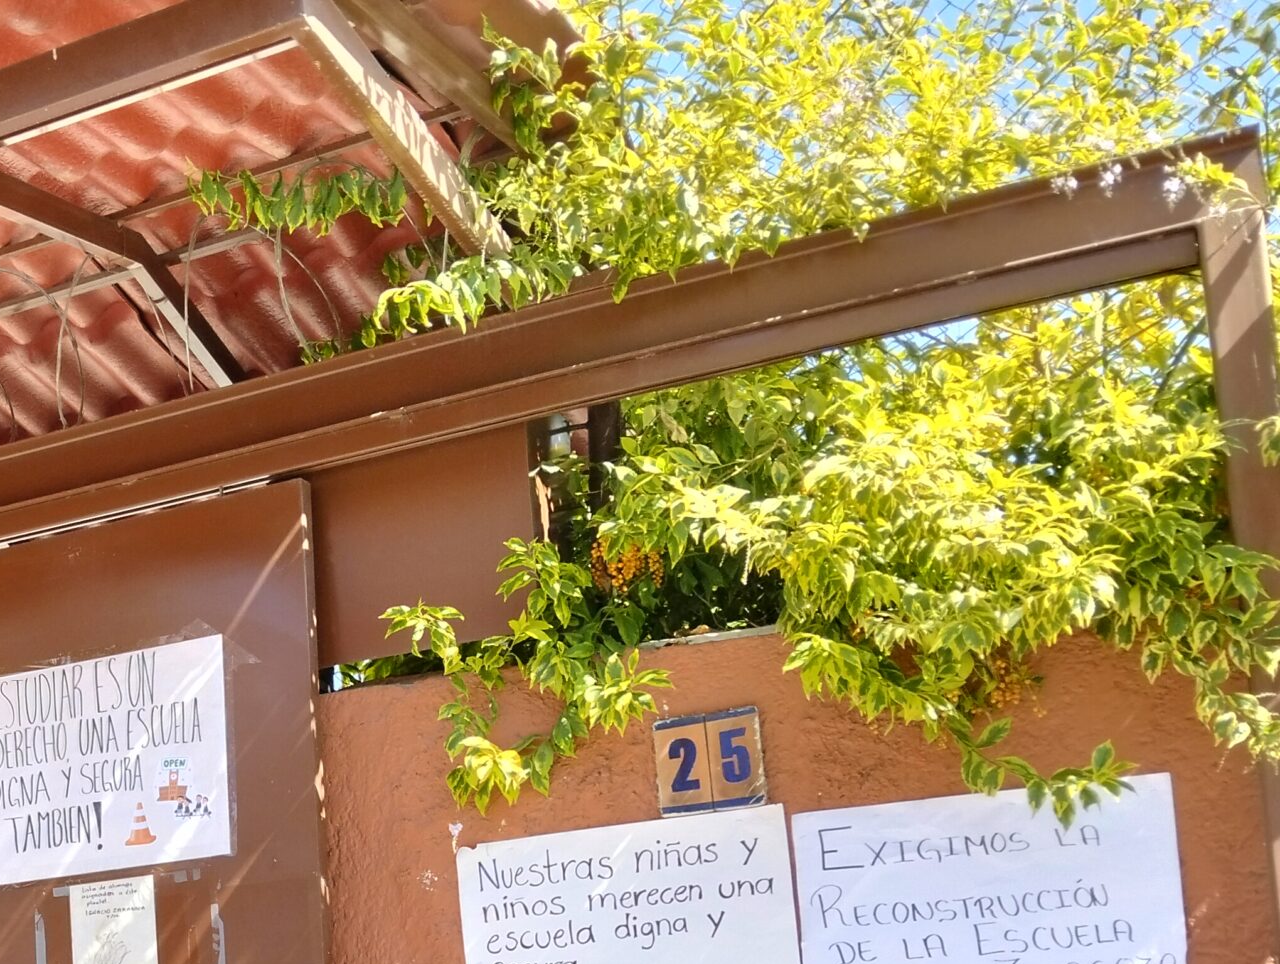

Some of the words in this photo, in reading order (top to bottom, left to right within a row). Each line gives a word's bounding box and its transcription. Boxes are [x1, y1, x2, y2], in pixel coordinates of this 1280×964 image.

[95, 657, 122, 713] ES
[78, 714, 119, 756] UNA
[128, 697, 202, 750] ESCUELA
[62, 768, 71, 798] Y
[80, 755, 143, 794] SEGURA
[163, 759, 186, 767] OPEN
[668, 727, 751, 792] 25
[3, 801, 103, 853] TAMBIEN!
[1054, 825, 1100, 847] LA
[478, 849, 613, 892] Nuestras
[635, 840, 718, 874] niñas
[741, 838, 758, 865] y
[482, 895, 566, 923] niños
[588, 883, 702, 911] merecen
[719, 877, 774, 898] una
[487, 920, 595, 954] escuela
[615, 914, 687, 950] digna
[707, 911, 724, 937] y
[904, 934, 947, 960] LA
[974, 919, 1134, 957] ESCUELA
